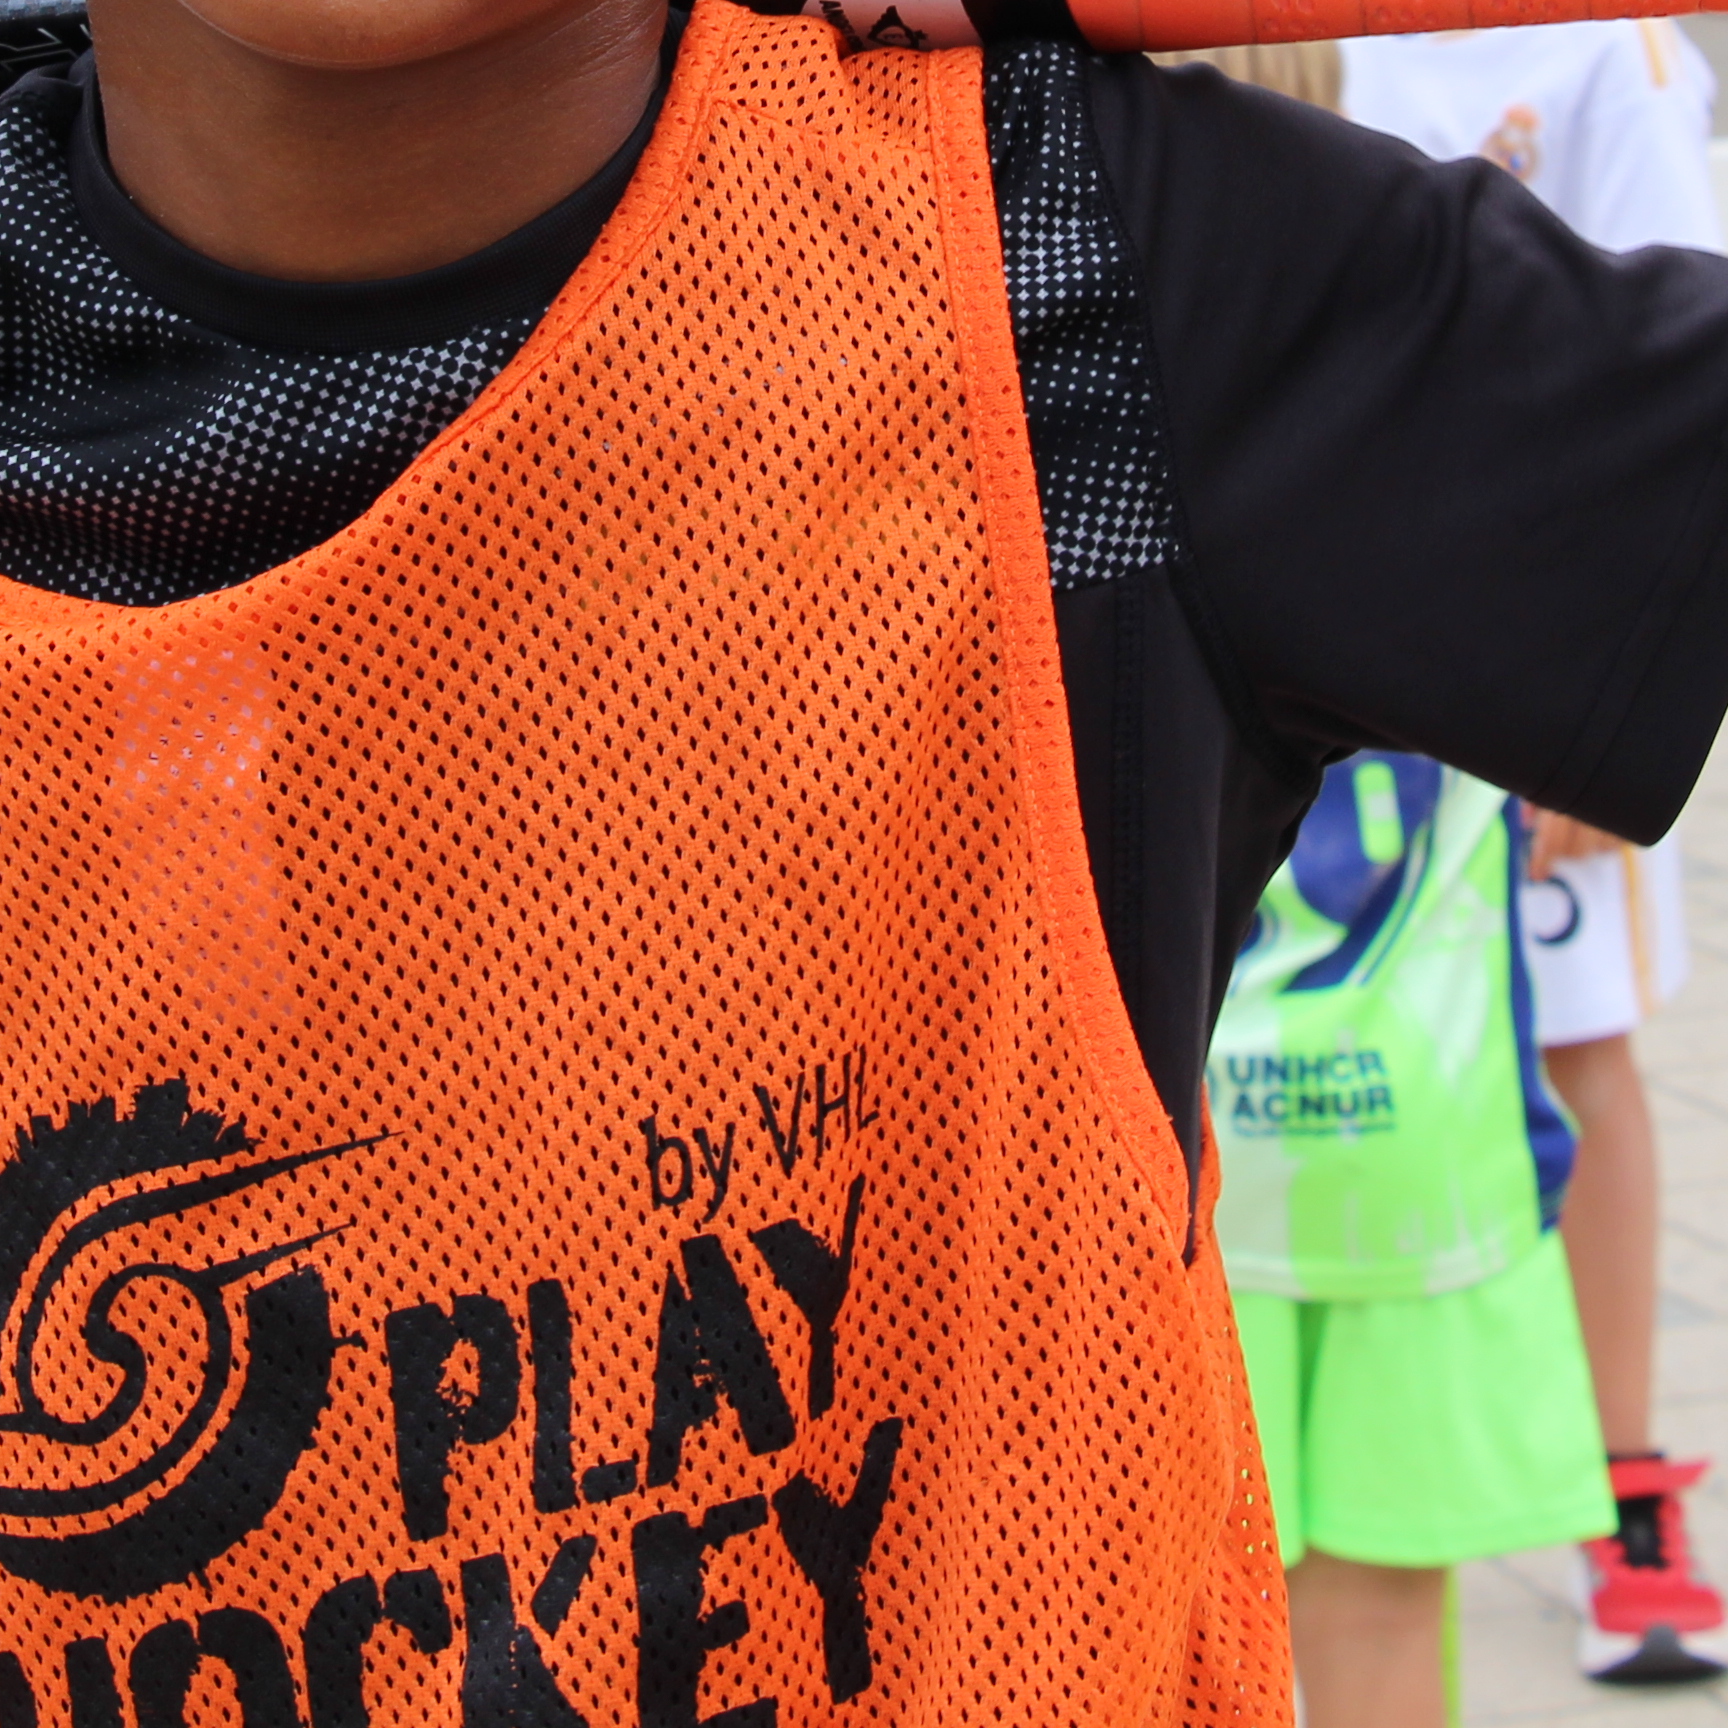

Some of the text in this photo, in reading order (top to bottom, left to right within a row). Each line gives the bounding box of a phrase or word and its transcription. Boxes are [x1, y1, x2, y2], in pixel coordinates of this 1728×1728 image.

[1227, 1051, 1386, 1085] UNHCR
[1232, 1085, 1395, 1122] ACNUR
[638, 1042, 880, 1224] by VHL
[384, 1173, 866, 1540] PLAY
